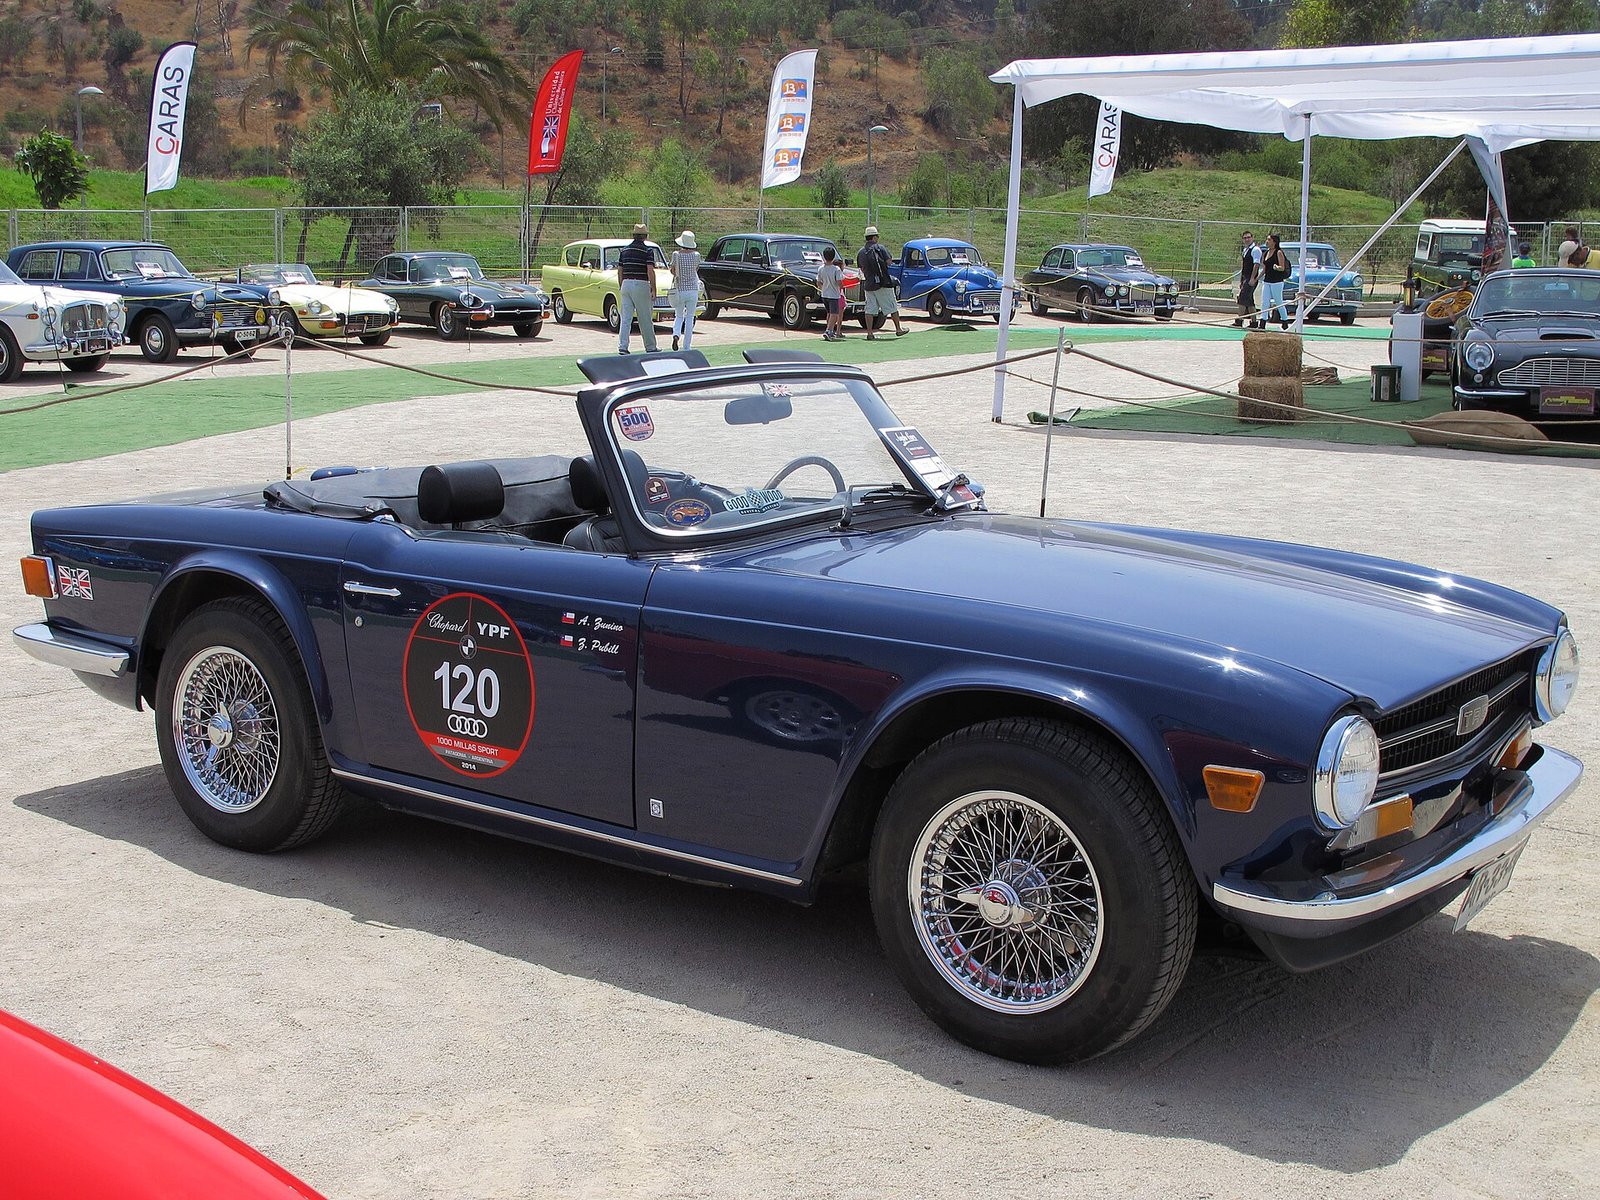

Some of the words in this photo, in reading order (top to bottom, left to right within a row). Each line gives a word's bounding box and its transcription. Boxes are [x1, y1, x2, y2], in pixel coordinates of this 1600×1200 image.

[545, 71, 560, 114] Universidad
[783, 83, 797, 94] 13
[155, 66, 184, 155] CARAS
[780, 117, 794, 129] 13
[776, 152, 790, 163] 13
[621, 412, 649, 427] 500
[726, 495, 750, 511] GOOD
[760, 489, 784, 504] WOOD
[427, 612, 469, 633] Chopard
[476, 621, 511, 639] YPF
[577, 615, 590, 626] A.
[593, 617, 624, 632] Zunino
[591, 639, 620, 654] Pubill
[434, 661, 500, 718] 120
[436, 736, 453, 746] 1000
[453, 740, 477, 752] MILLAS
[477, 745, 499, 756] SPORT
[461, 761, 476, 771] 2014
